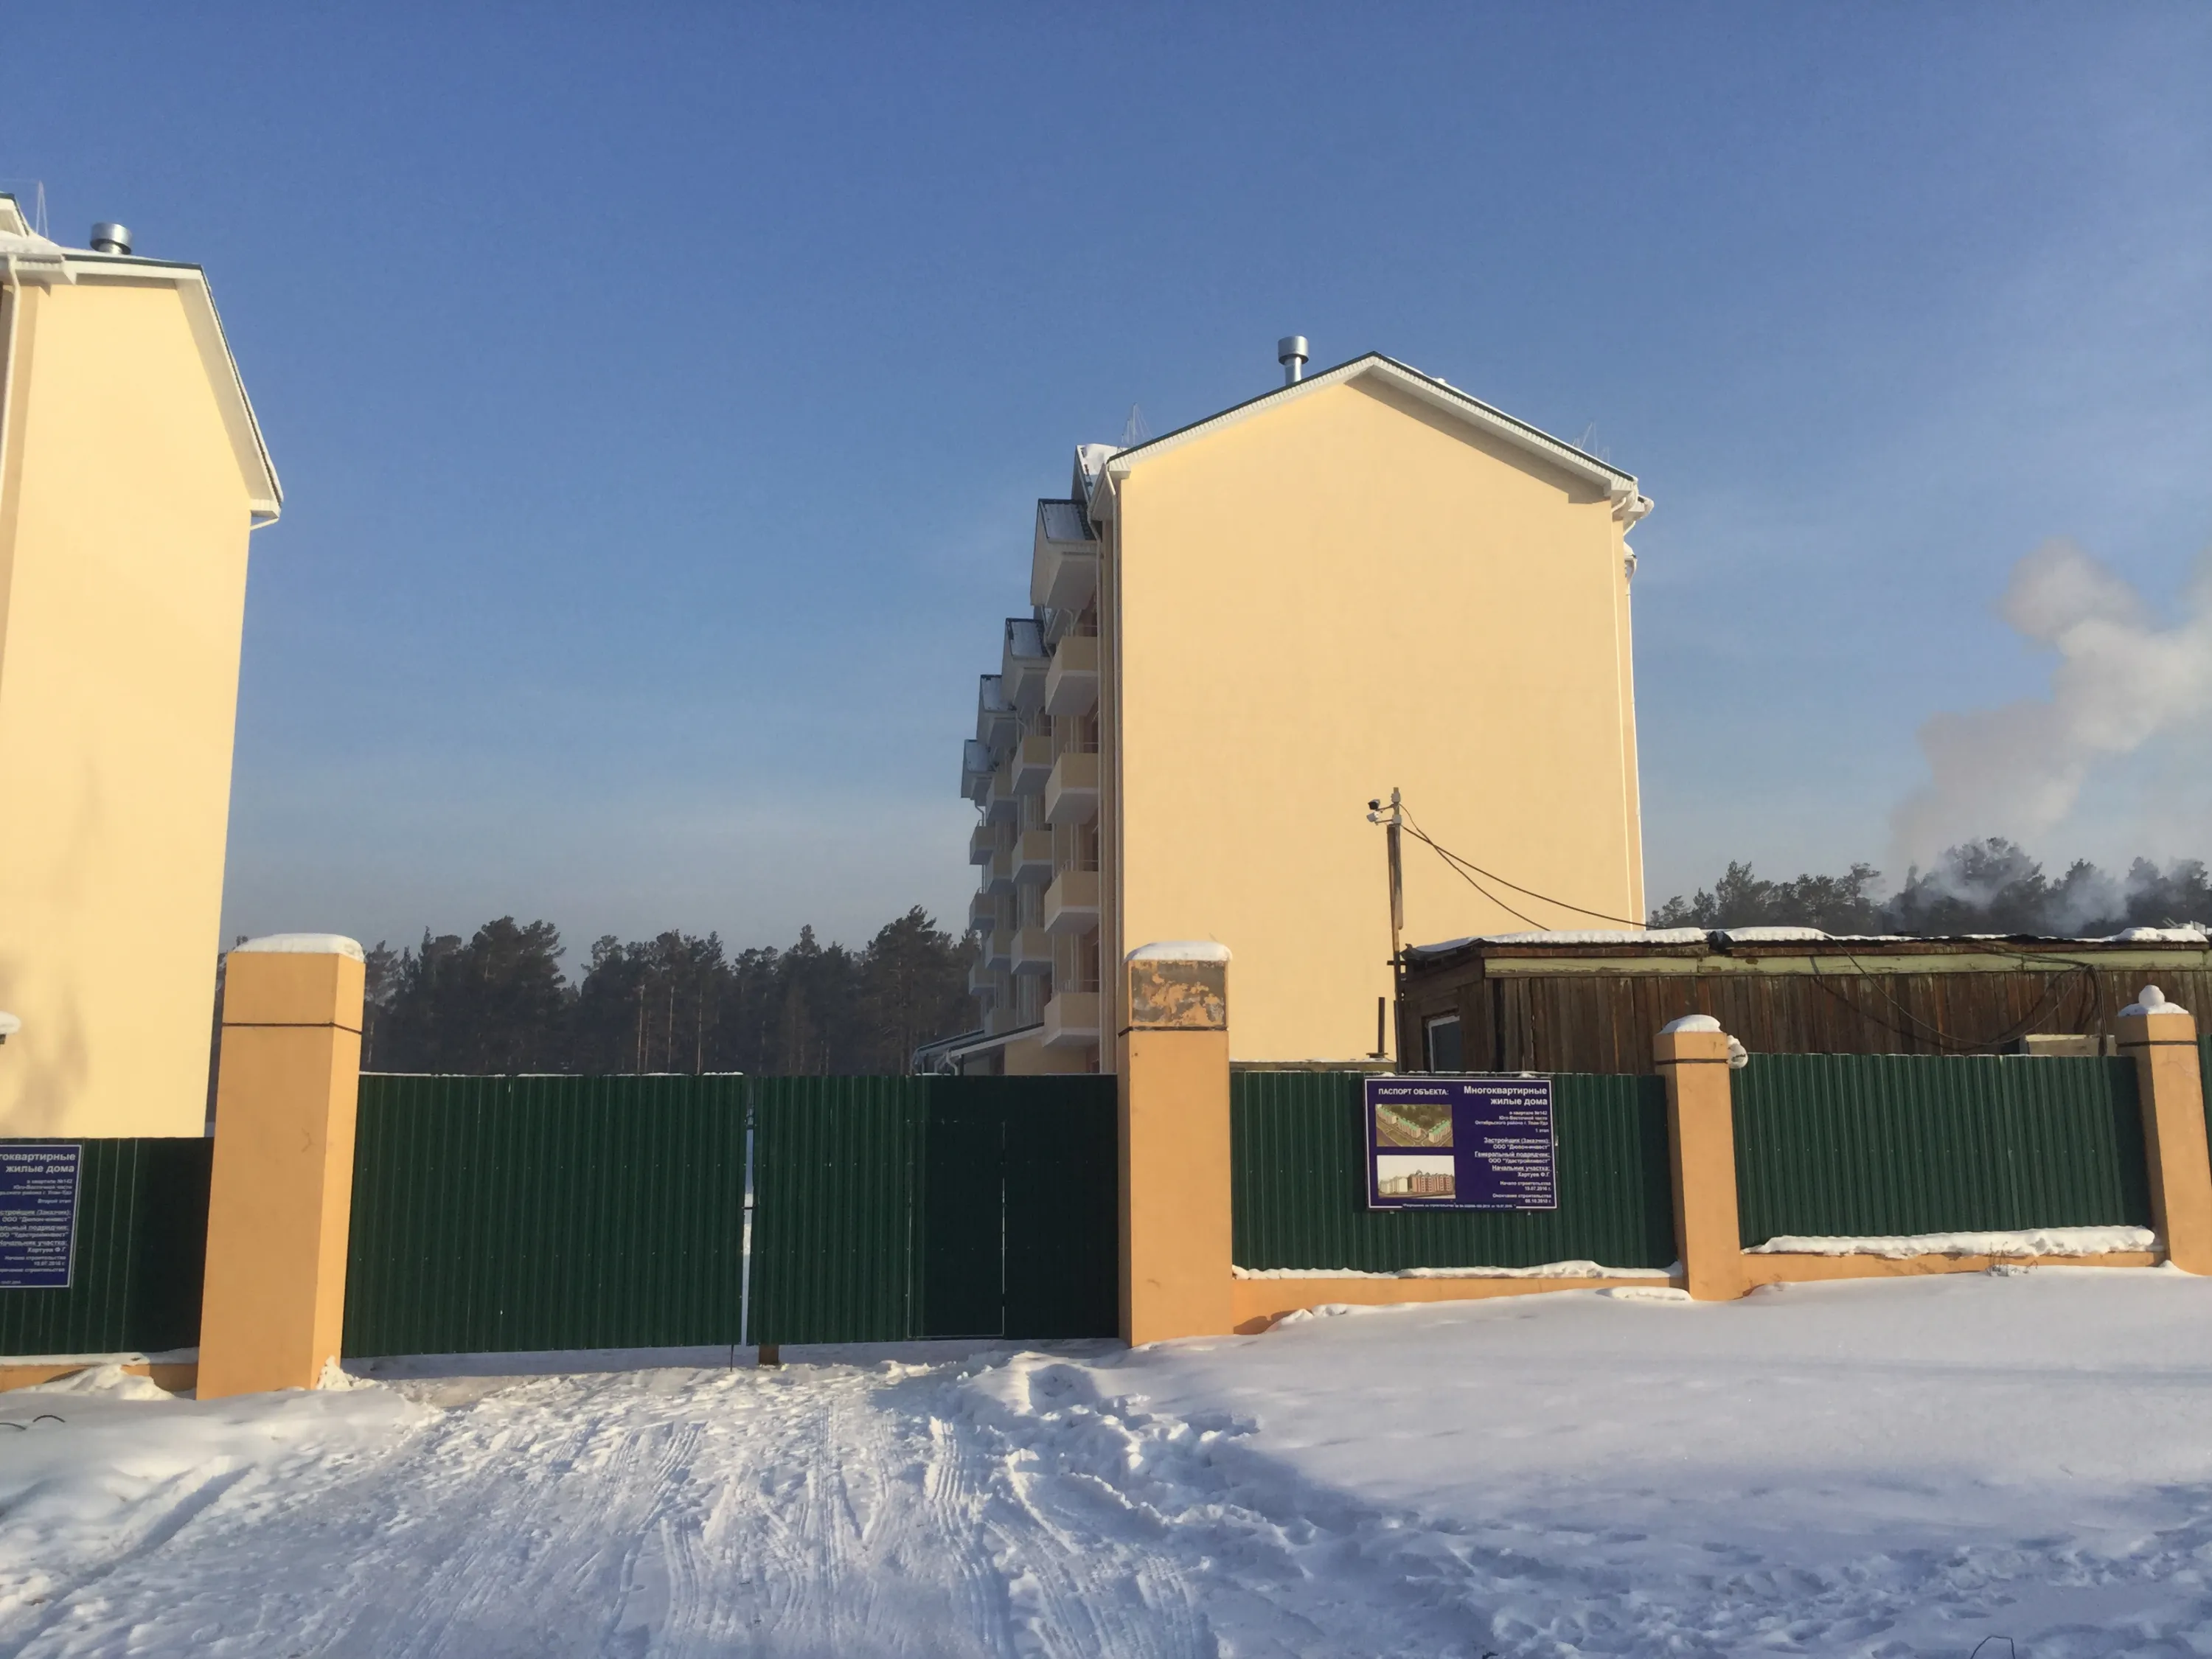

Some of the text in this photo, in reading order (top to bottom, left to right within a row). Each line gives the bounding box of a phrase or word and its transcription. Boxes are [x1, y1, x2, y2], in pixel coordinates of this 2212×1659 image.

[1464, 1085, 1547, 1096] Многоквартирные
[1523, 1098, 1548, 1106] дома
[5, 1165, 74, 1174] жилые дома
